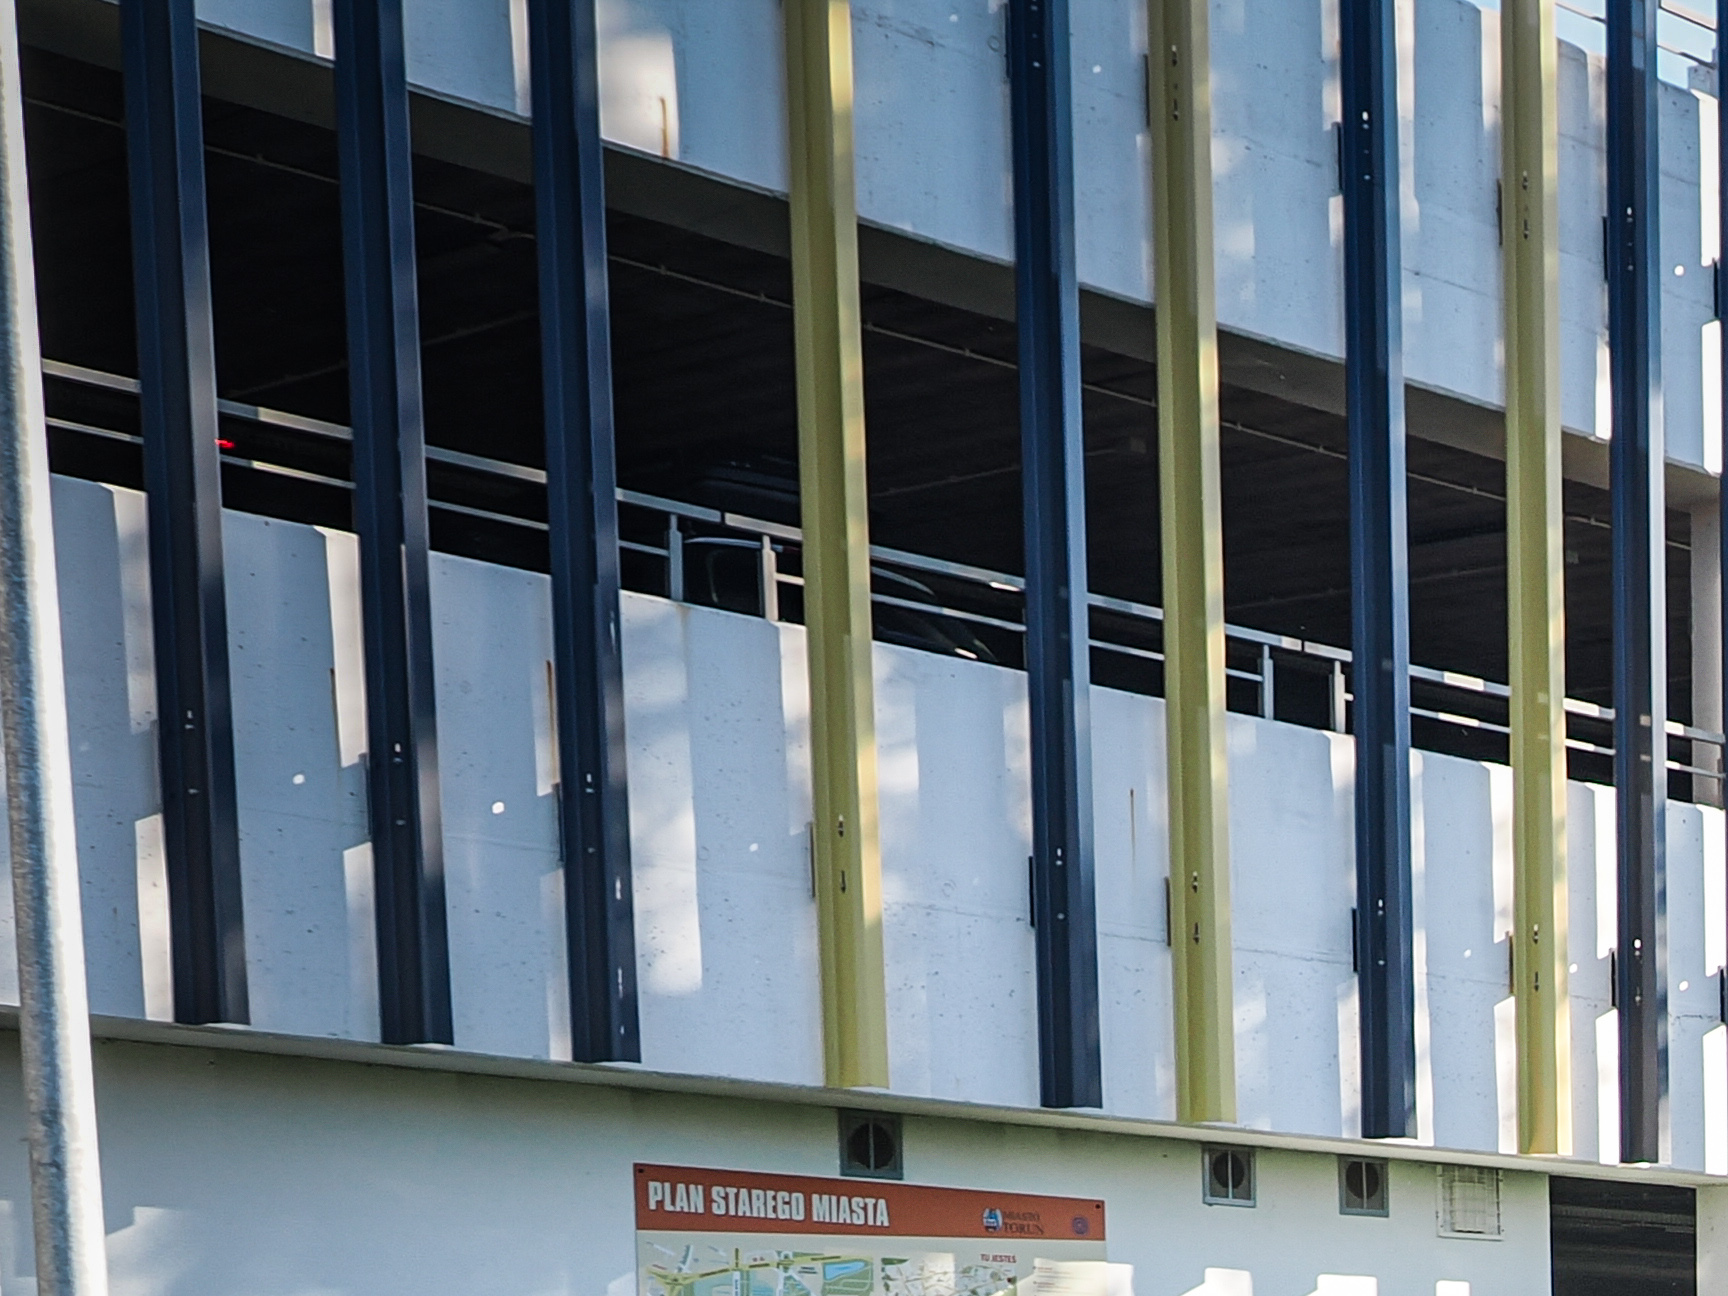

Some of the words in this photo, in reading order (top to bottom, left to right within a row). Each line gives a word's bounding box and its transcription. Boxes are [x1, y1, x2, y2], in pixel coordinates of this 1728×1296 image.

[648, 1180, 705, 1214] PLAN
[711, 1186, 805, 1222] STAREGO
[811, 1193, 890, 1227] MIASTA
